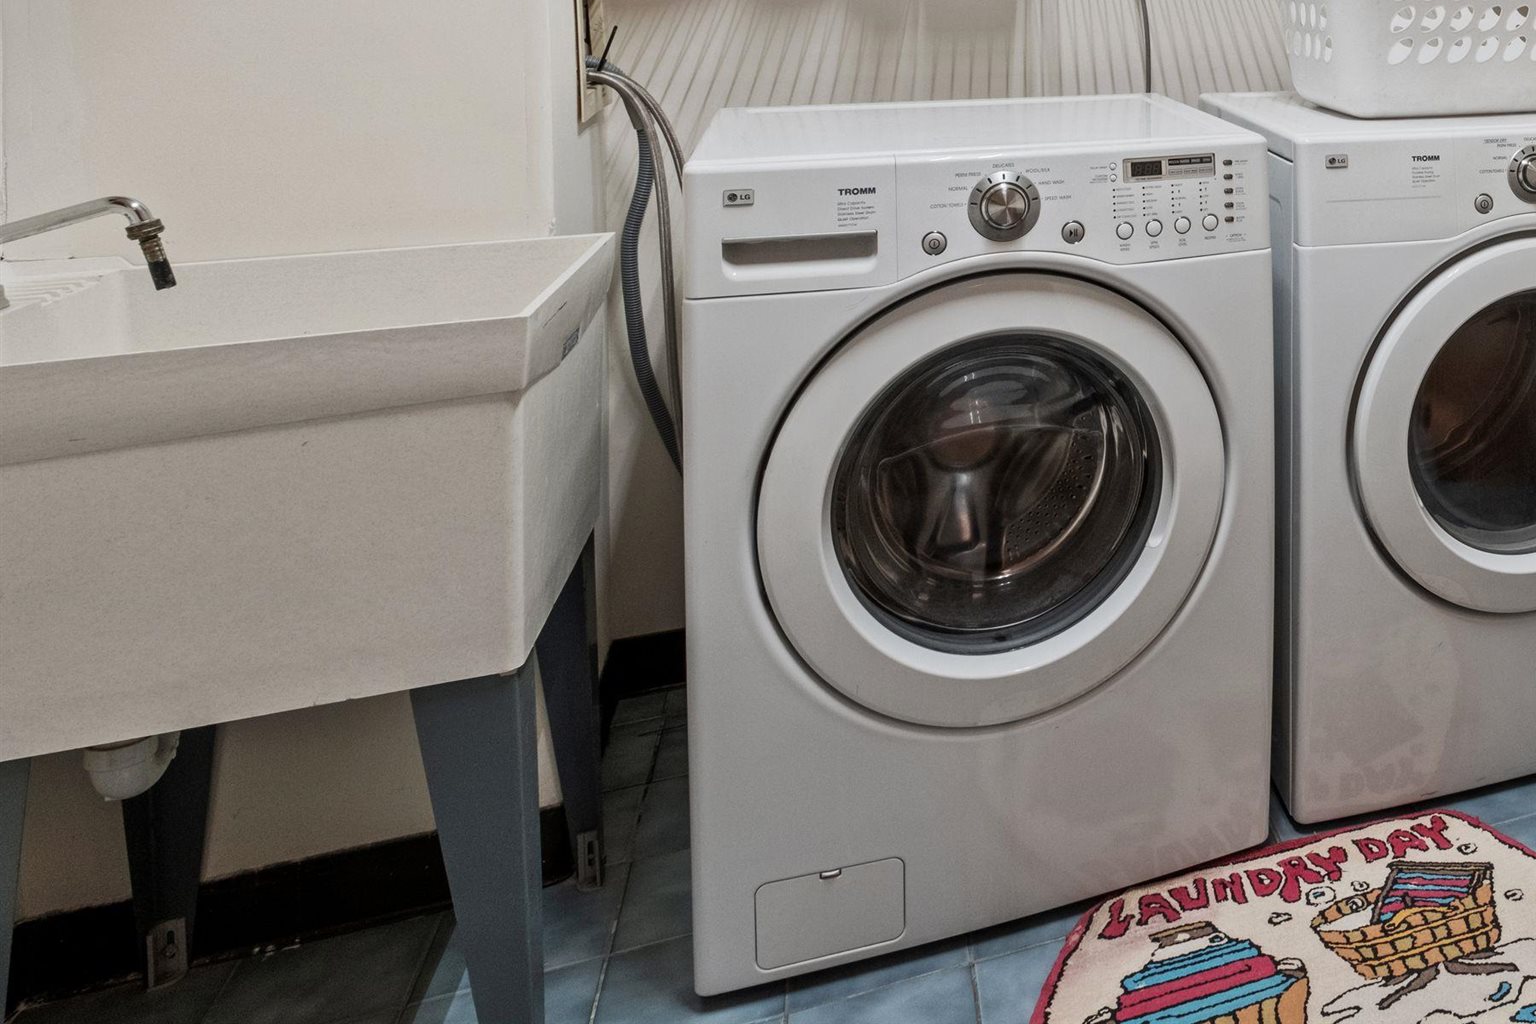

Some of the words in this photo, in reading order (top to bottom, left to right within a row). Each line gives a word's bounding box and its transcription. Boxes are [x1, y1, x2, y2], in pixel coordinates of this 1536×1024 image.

[837, 187, 876, 196] TROMM
[739, 193, 751, 201] LG
[1097, 844, 1350, 939] LAUNDRY
[1352, 813, 1453, 863] DAY
